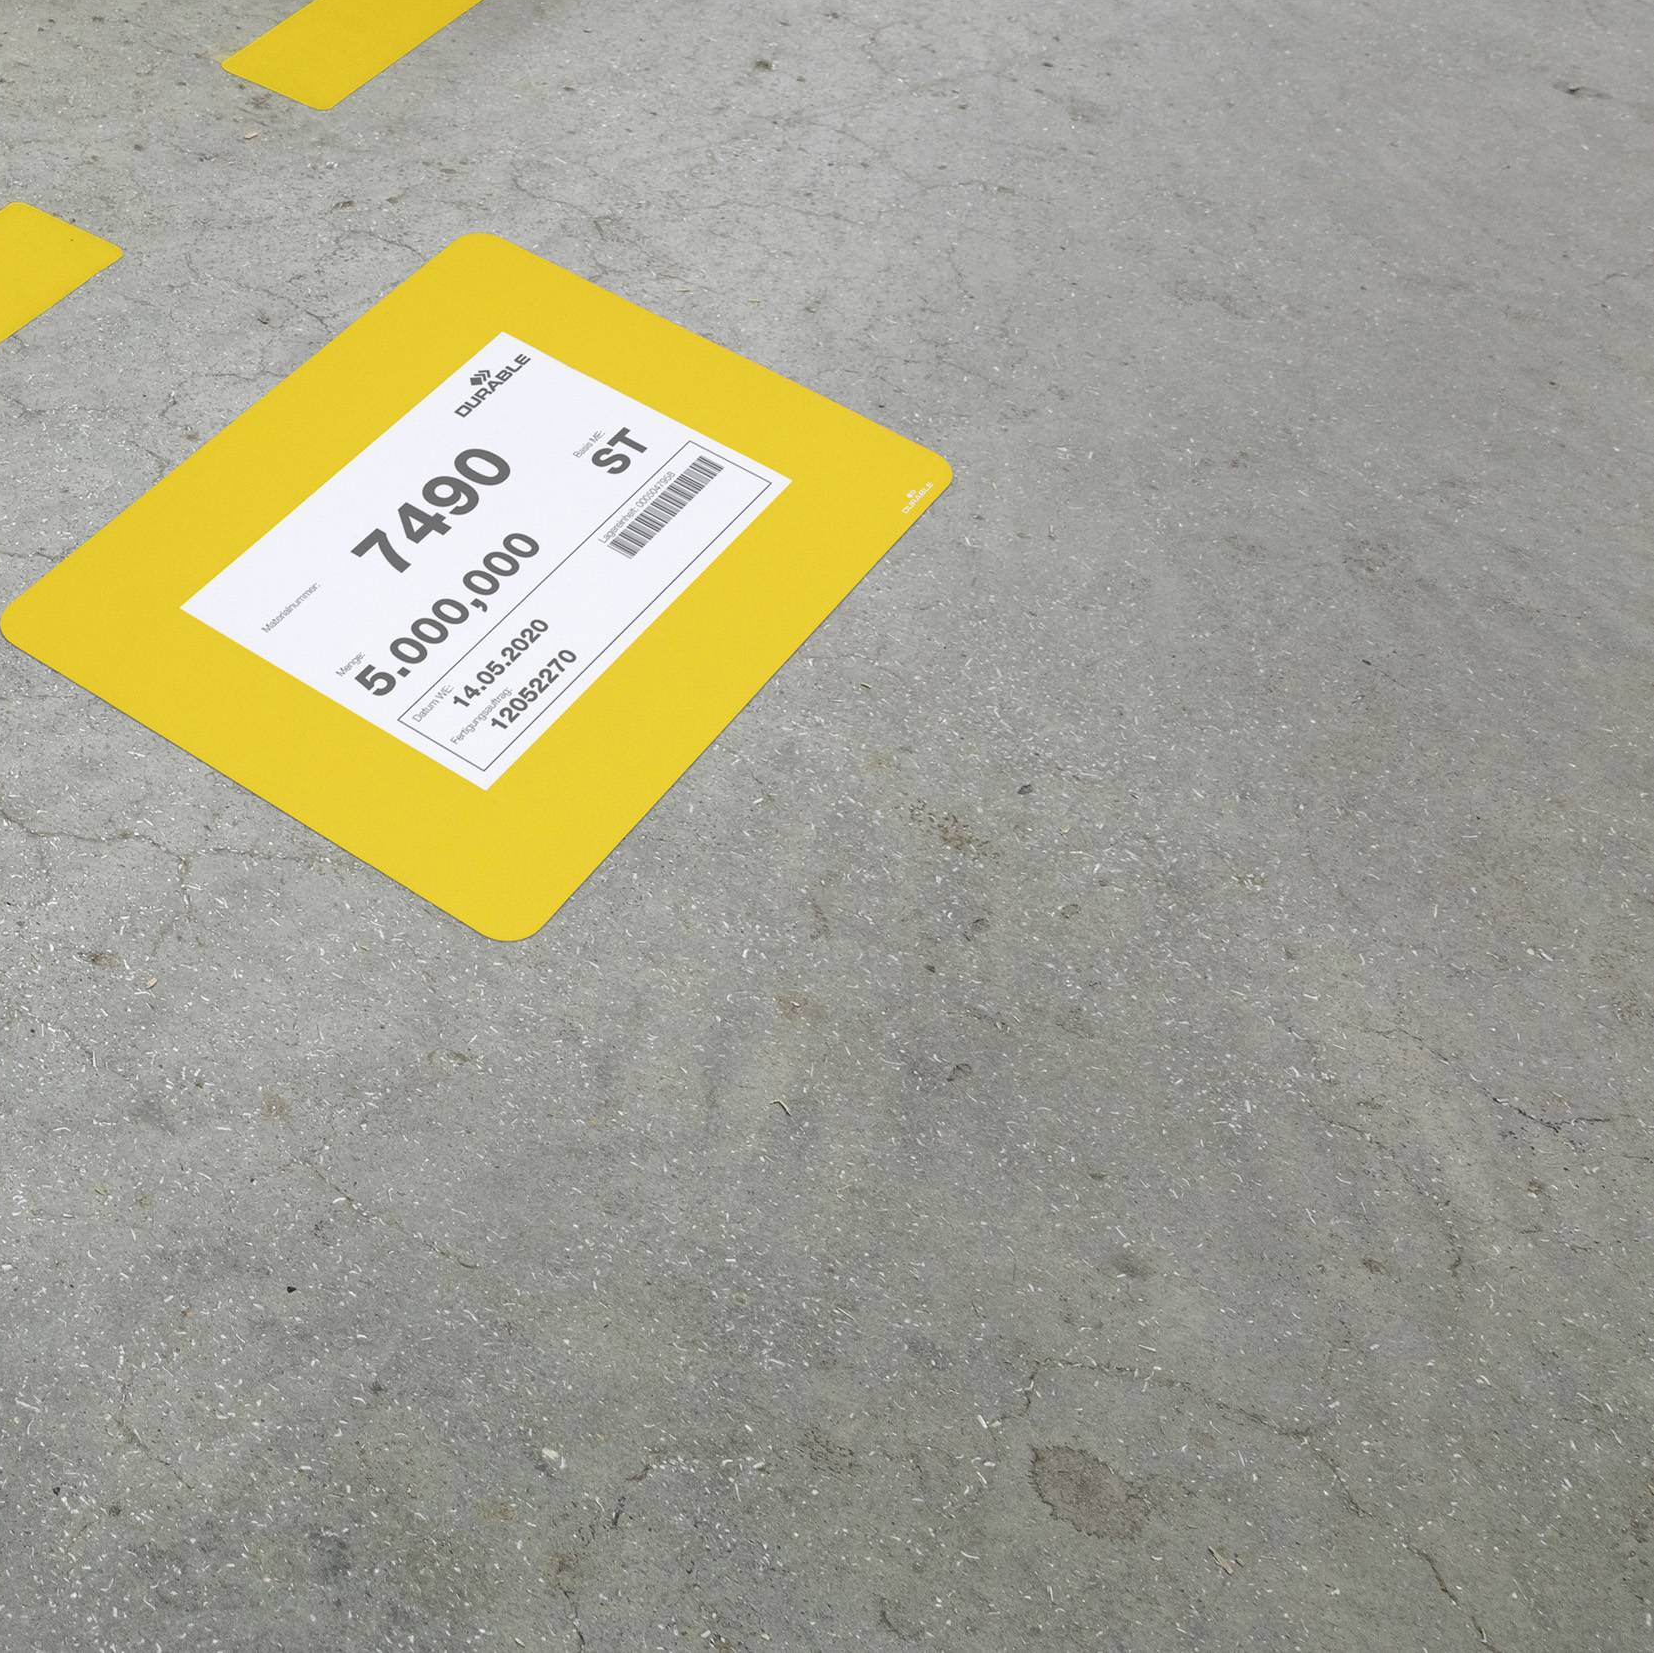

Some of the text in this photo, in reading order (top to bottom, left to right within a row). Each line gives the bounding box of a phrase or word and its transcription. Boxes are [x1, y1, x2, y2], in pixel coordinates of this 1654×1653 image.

[454, 354, 531, 418] DURABLE
[591, 427, 648, 474] ST
[350, 449, 511, 573] 7490
[261, 583, 320, 632] Materialnummer:
[354, 533, 539, 696] 5.000,000
[335, 652, 365, 677] Menge:
[453, 619, 548, 707] 14.05.2020
[491, 650, 577, 729] 12052270
[412, 700, 439, 722] Datum
[450, 687, 512, 744] Fertigungsauftrag:
